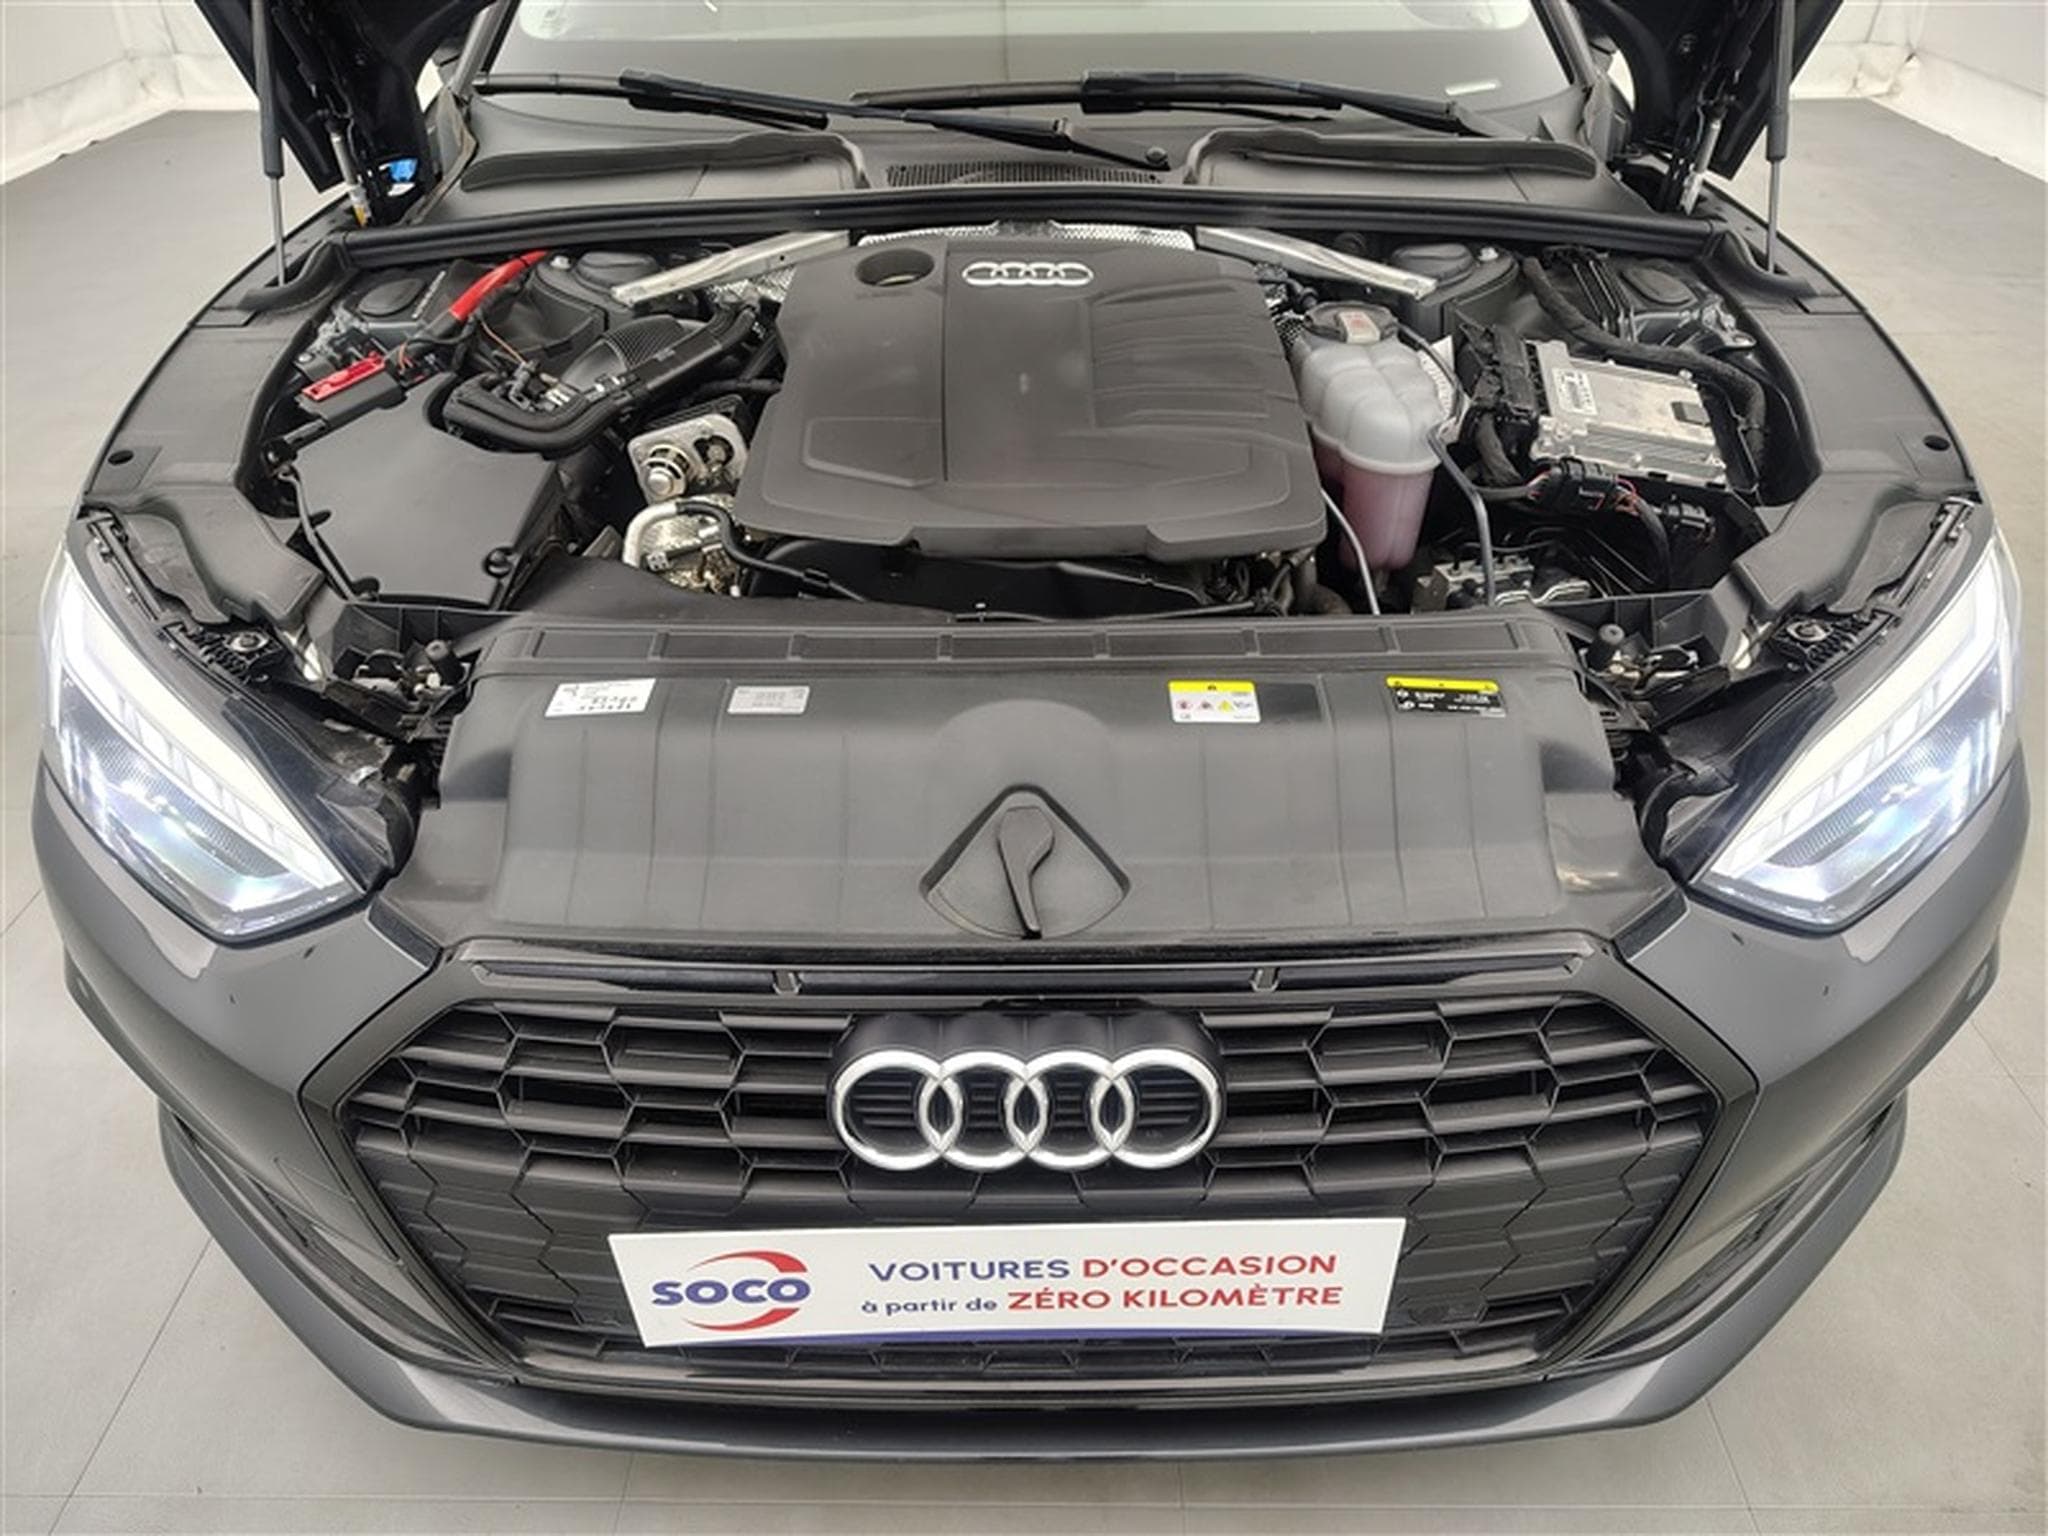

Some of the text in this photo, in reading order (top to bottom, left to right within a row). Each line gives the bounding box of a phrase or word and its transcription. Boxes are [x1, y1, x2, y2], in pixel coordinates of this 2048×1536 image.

[868, 1255, 1337, 1281] VOITURES D'OCCASION
[651, 1277, 811, 1306] SOCO
[861, 1283, 1344, 1316] à partir de ZÉRO KILOMÈTRE
